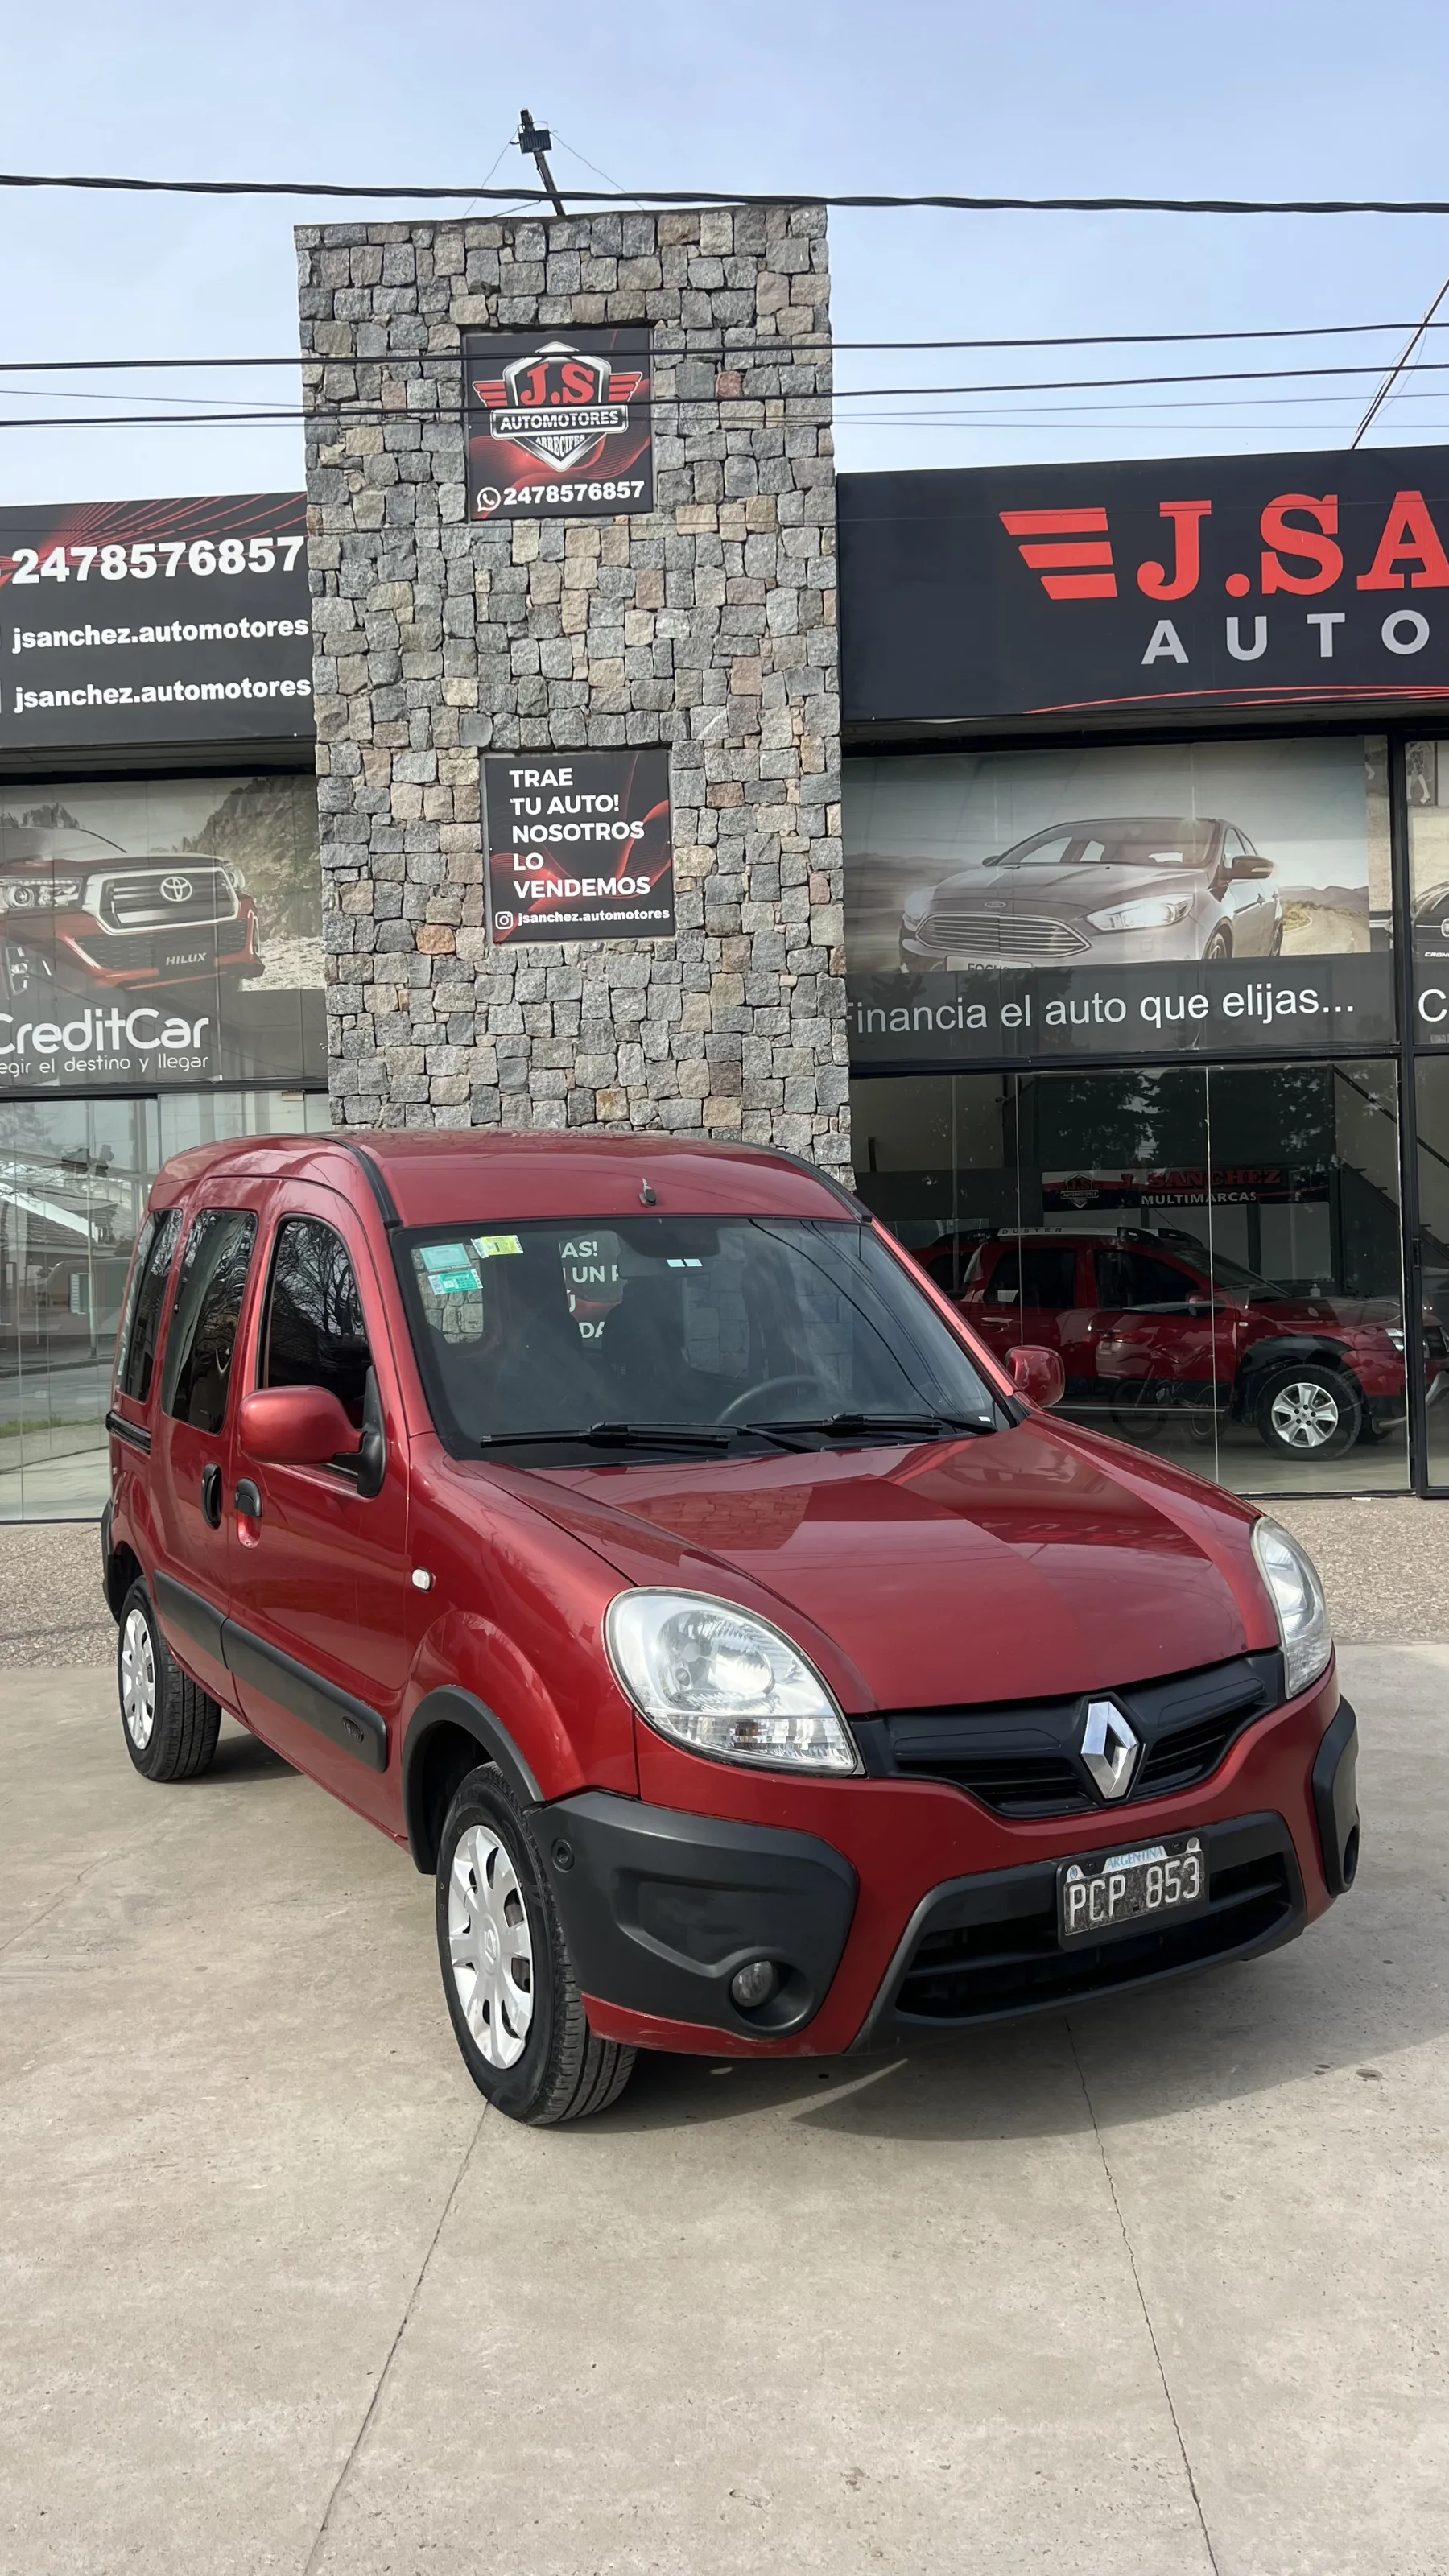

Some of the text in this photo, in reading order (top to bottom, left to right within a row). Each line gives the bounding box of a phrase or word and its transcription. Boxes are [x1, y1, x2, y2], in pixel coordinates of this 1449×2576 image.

[520, 361, 595, 406] J.S
[500, 411, 619, 431] AUTOMOTORES
[535, 434, 585, 457] ARRECIFES
[503, 481, 645, 506] 2478576857
[1137, 490, 1449, 601] J.SA
[12, 535, 305, 584] 2478576857
[12, 618, 309, 654] jsanchez.automotores
[1141, 609, 1430, 665] AUTO
[14, 678, 312, 713] jsanchez.automotores
[509, 767, 573, 788] TRAE
[510, 794, 619, 815] TU AUTO!
[512, 821, 645, 844] NOSOTROS
[513, 852, 544, 871] LO
[514, 876, 651, 899] VENDEMOS
[518, 910, 670, 926] jsanchez.automotores
[165, 952, 207, 967] HILUX
[1001, 994, 1030, 1027] el
[1046, 992, 1127, 1025] auto
[1140, 994, 1209, 1029] que
[1222, 982, 1354, 1025] elijas...
[39, 1057, 56, 1074] el
[64, 1055, 131, 1072] destino
[138, 1057, 150, 1073] y
[158, 1053, 209, 1072] llegar
[1141, 1191, 1257, 1206] MULTIMARCAS
[559, 1241, 598, 1259] AS!
[572, 1265, 605, 1283] UN
[1105, 1845, 1163, 1869] ARGENTINA
[1069, 1856, 1200, 1928] PCP 853
